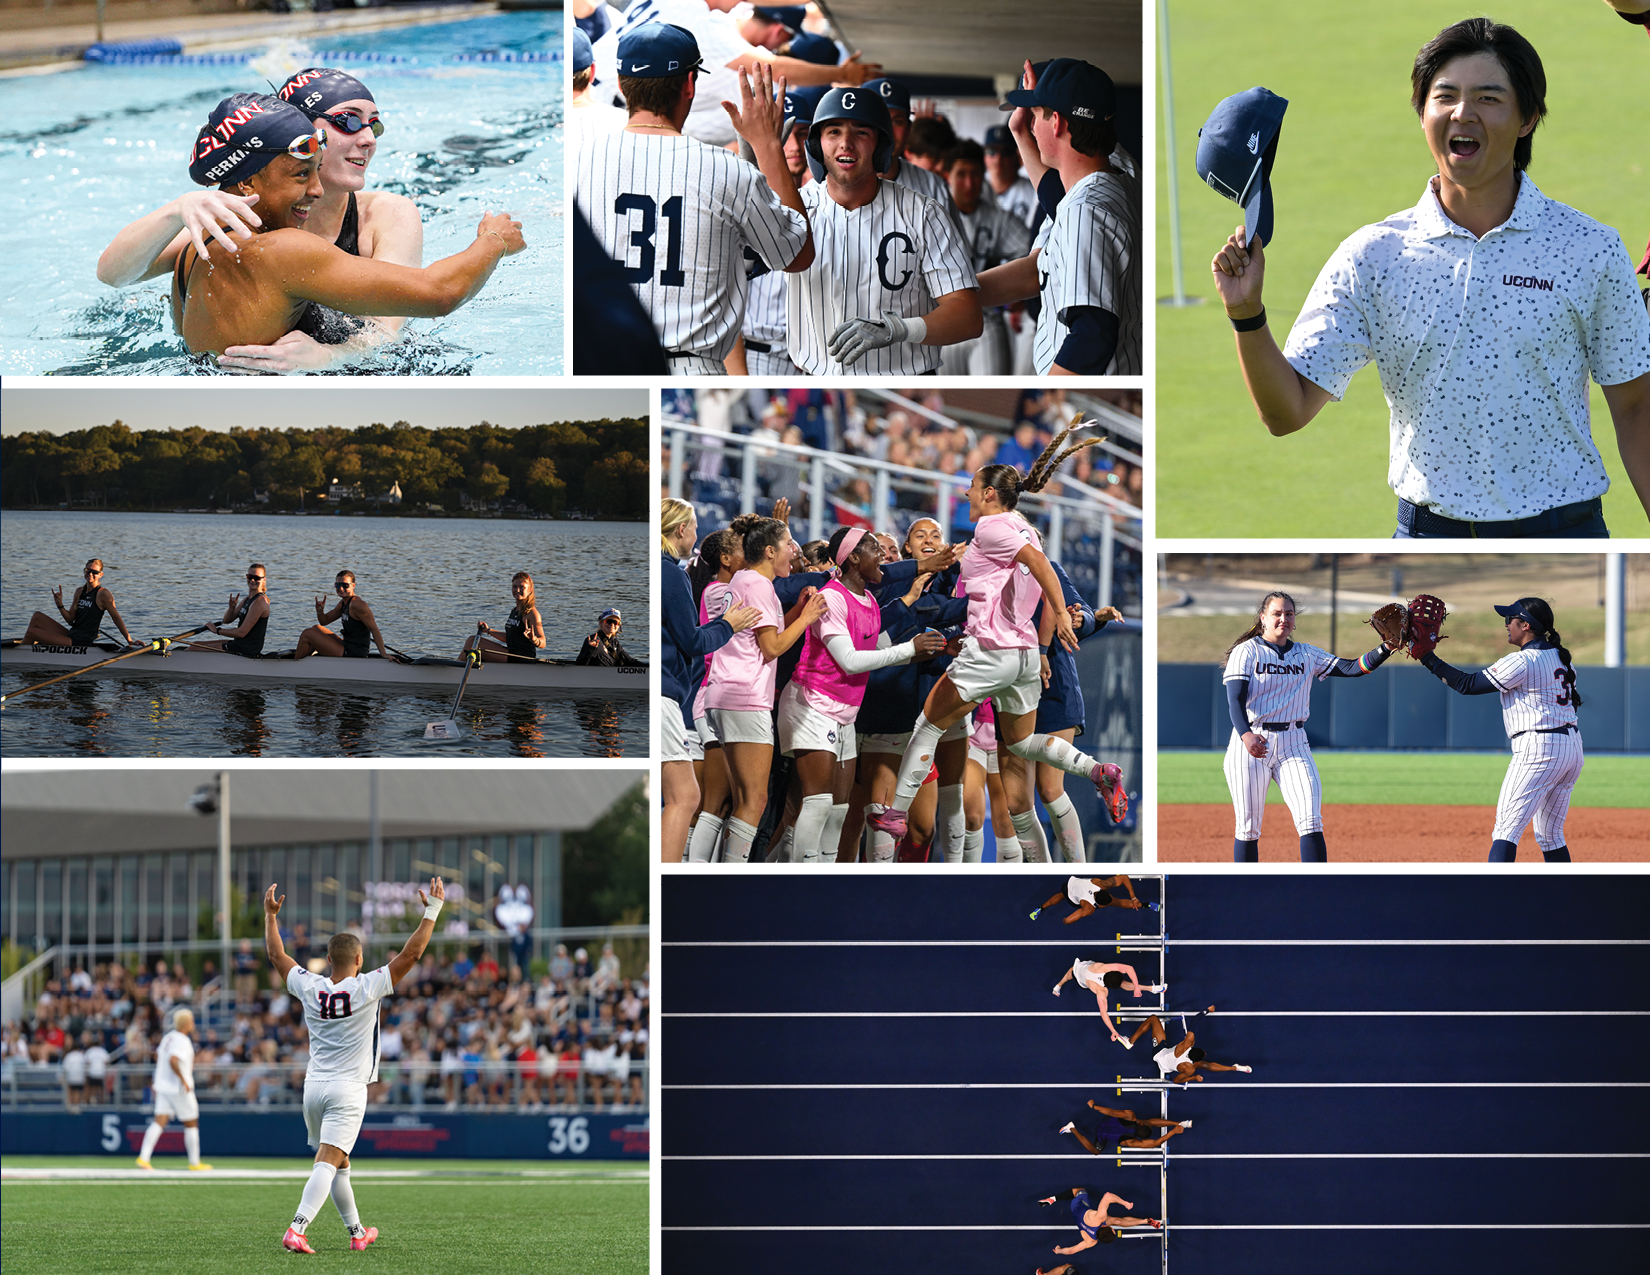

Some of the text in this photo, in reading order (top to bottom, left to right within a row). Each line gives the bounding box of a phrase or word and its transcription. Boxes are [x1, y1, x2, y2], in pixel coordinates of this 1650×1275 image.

[841, 92, 856, 110] C
[879, 82, 892, 97] C
[1247, 132, 1258, 150] NIKE
[614, 192, 685, 287] 31
[875, 231, 916, 291] C
[1502, 274, 1554, 292] UCONN
[617, 667, 646, 675] UCONN
[1255, 661, 1305, 675] UCONN
[1554, 667, 1572, 706] 3
[318, 990, 353, 1020] 10
[101, 1114, 122, 1152] 5
[548, 1116, 590, 1154] 36
